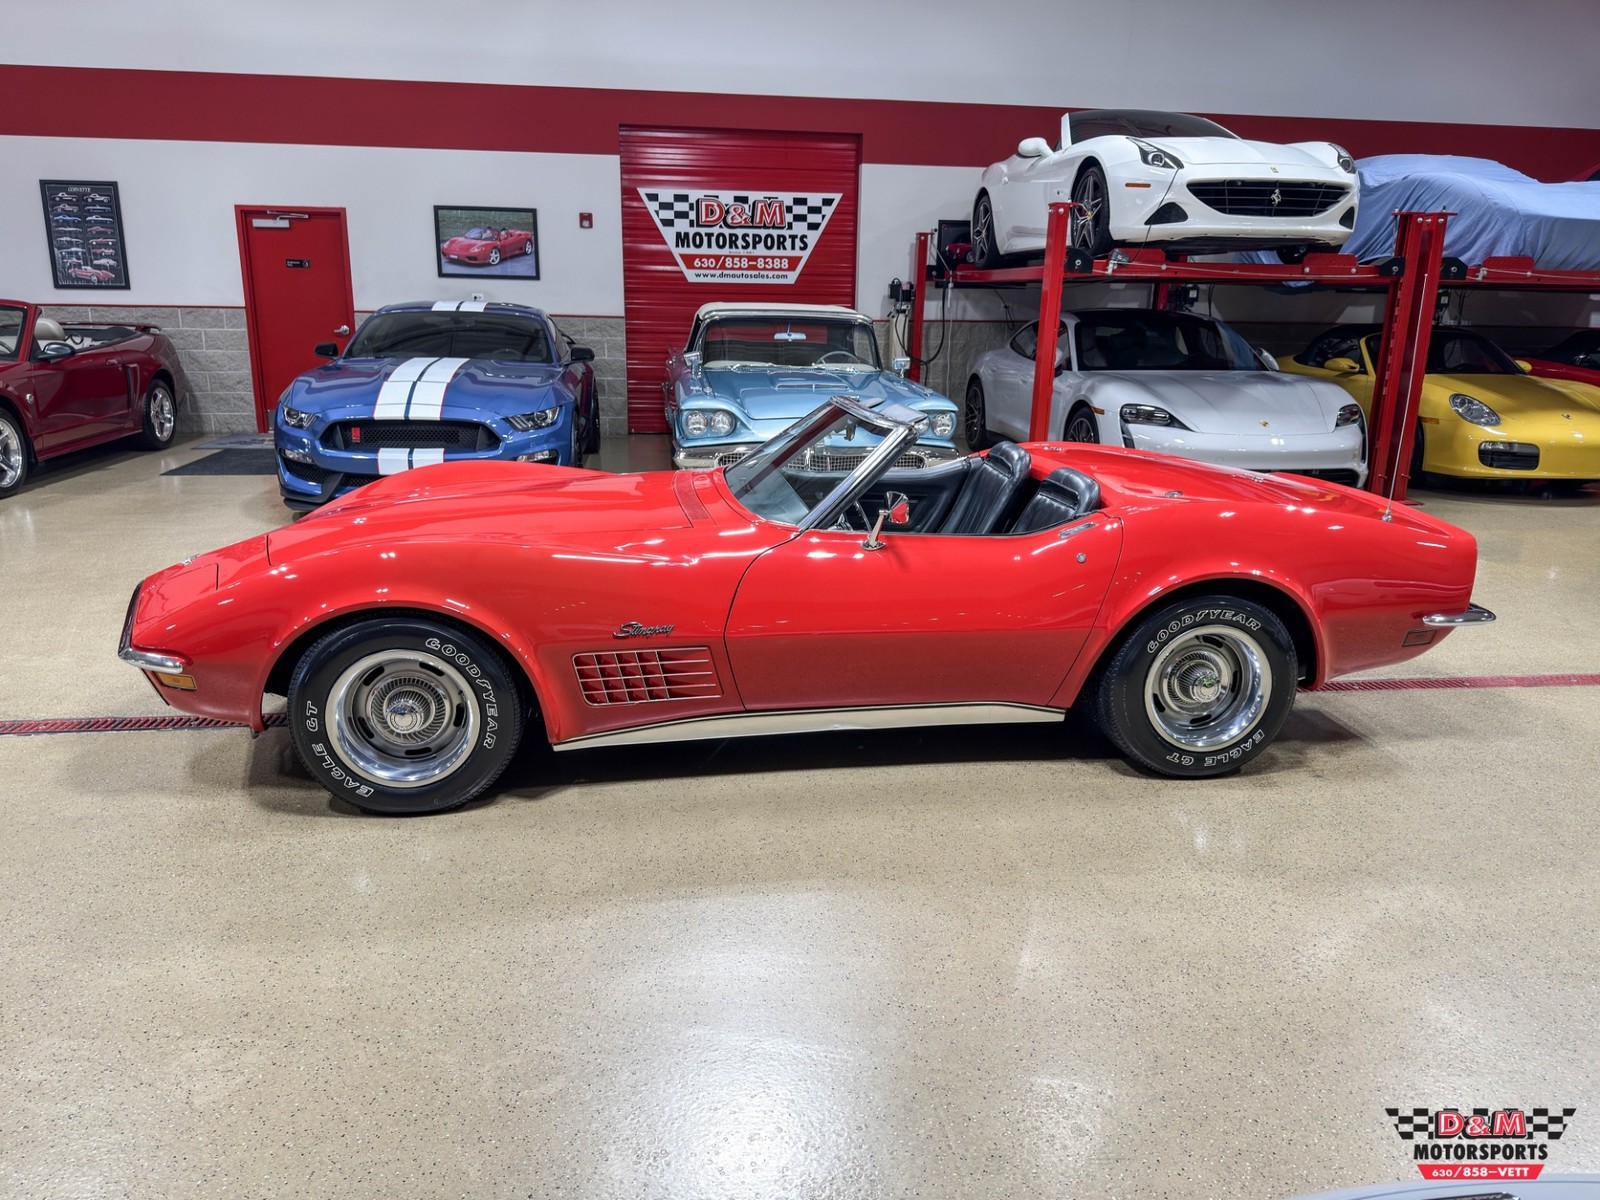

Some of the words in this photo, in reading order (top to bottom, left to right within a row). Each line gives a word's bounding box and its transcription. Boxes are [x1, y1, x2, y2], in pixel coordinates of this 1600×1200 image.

[696, 197, 787, 229] D&M
[675, 231, 808, 251] MOTORSPORTS
[693, 256, 789, 269] 630/858-8388
[694, 271, 788, 280] www.dmautosales.com
[612, 621, 675, 639] Stingray
[1147, 609, 1262, 654] GOODYEAR
[425, 638, 499, 749] GOODYEAR
[306, 701, 318, 732] GT
[1166, 752, 1195, 766] GT
[1204, 729, 1265, 767] EAGLE
[312, 743, 374, 797] EAGLE
